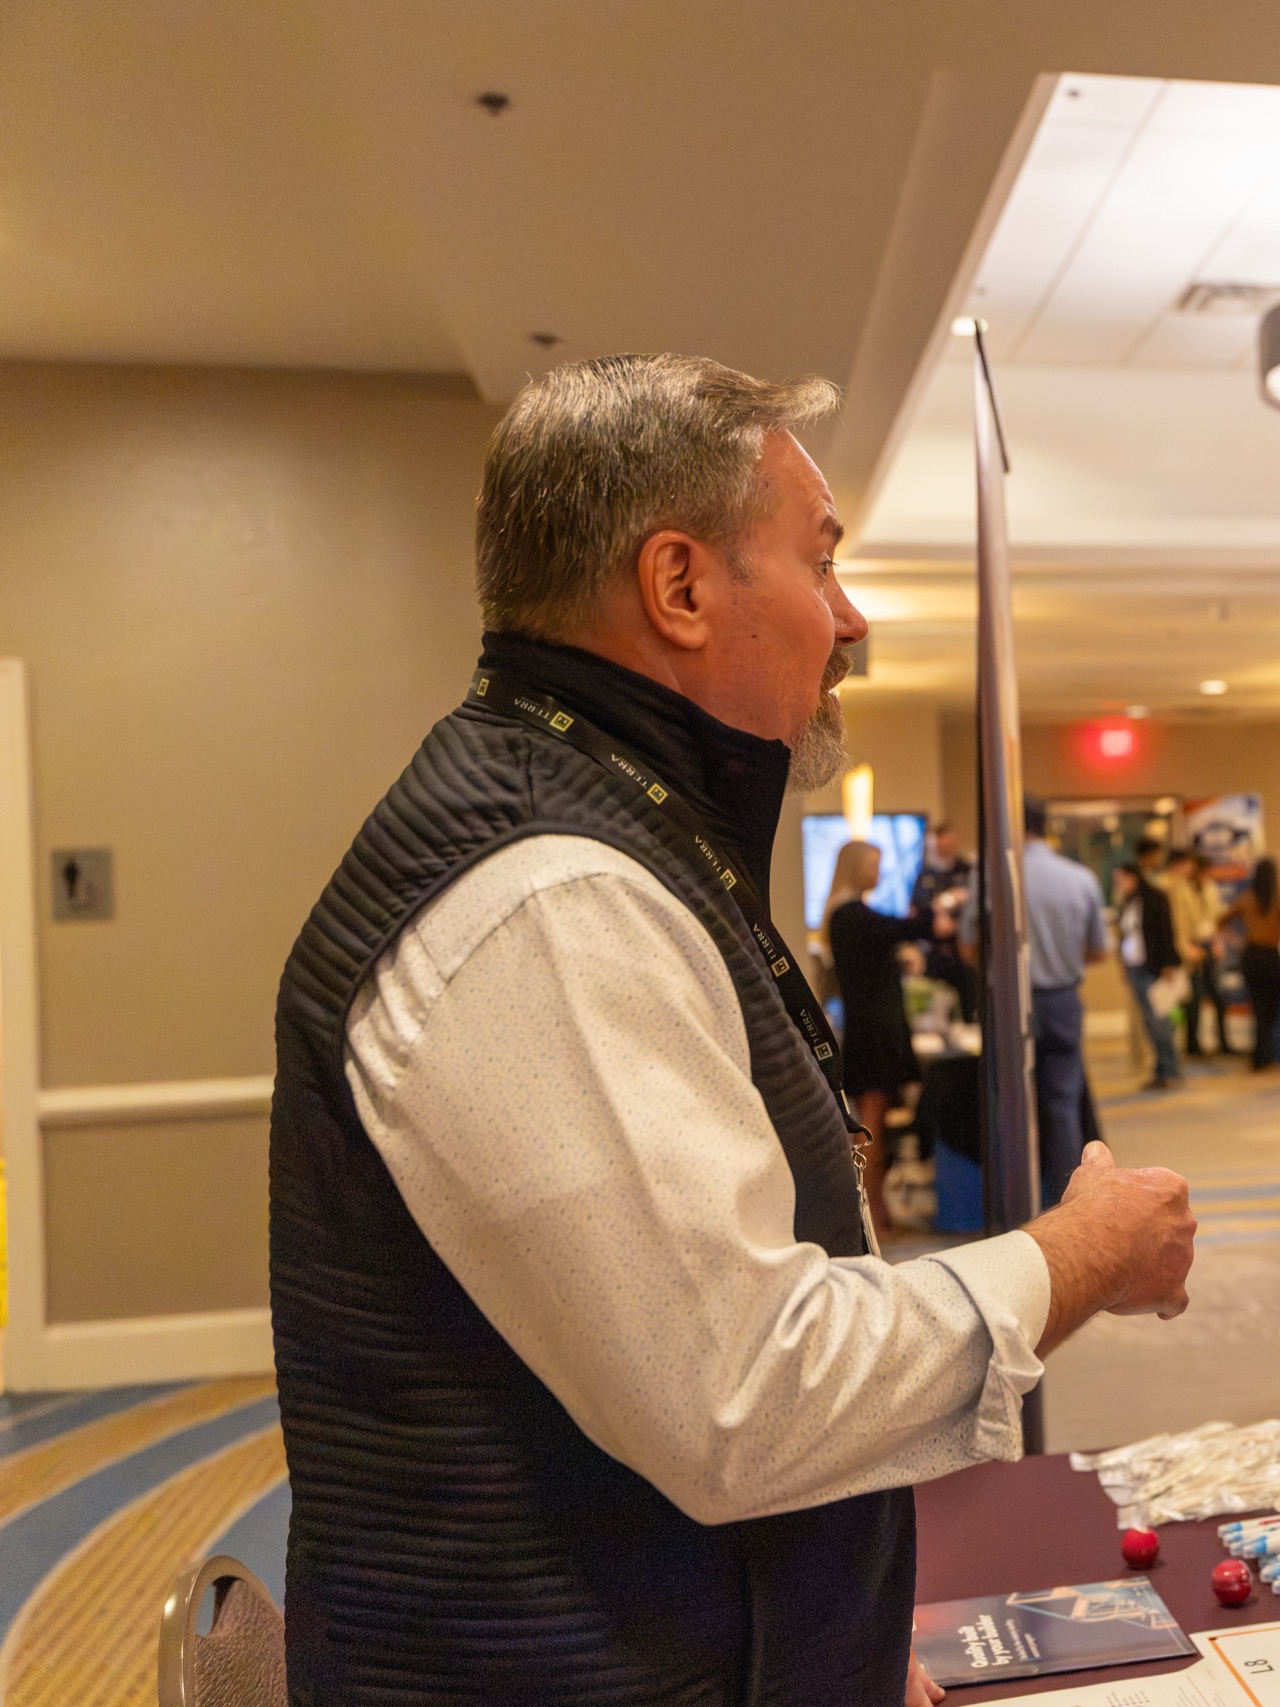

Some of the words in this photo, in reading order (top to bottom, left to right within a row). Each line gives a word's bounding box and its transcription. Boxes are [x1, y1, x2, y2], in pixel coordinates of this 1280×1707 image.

[611, 754, 648, 789] TERRA
[695, 834, 722, 873] TERRA
[752, 922, 776, 960] TERRA
[974, 1614, 999, 1640] builder
[965, 1641, 989, 1668] Quality
[987, 1638, 1011, 1656] your
[991, 1655, 1013, 1666] by
